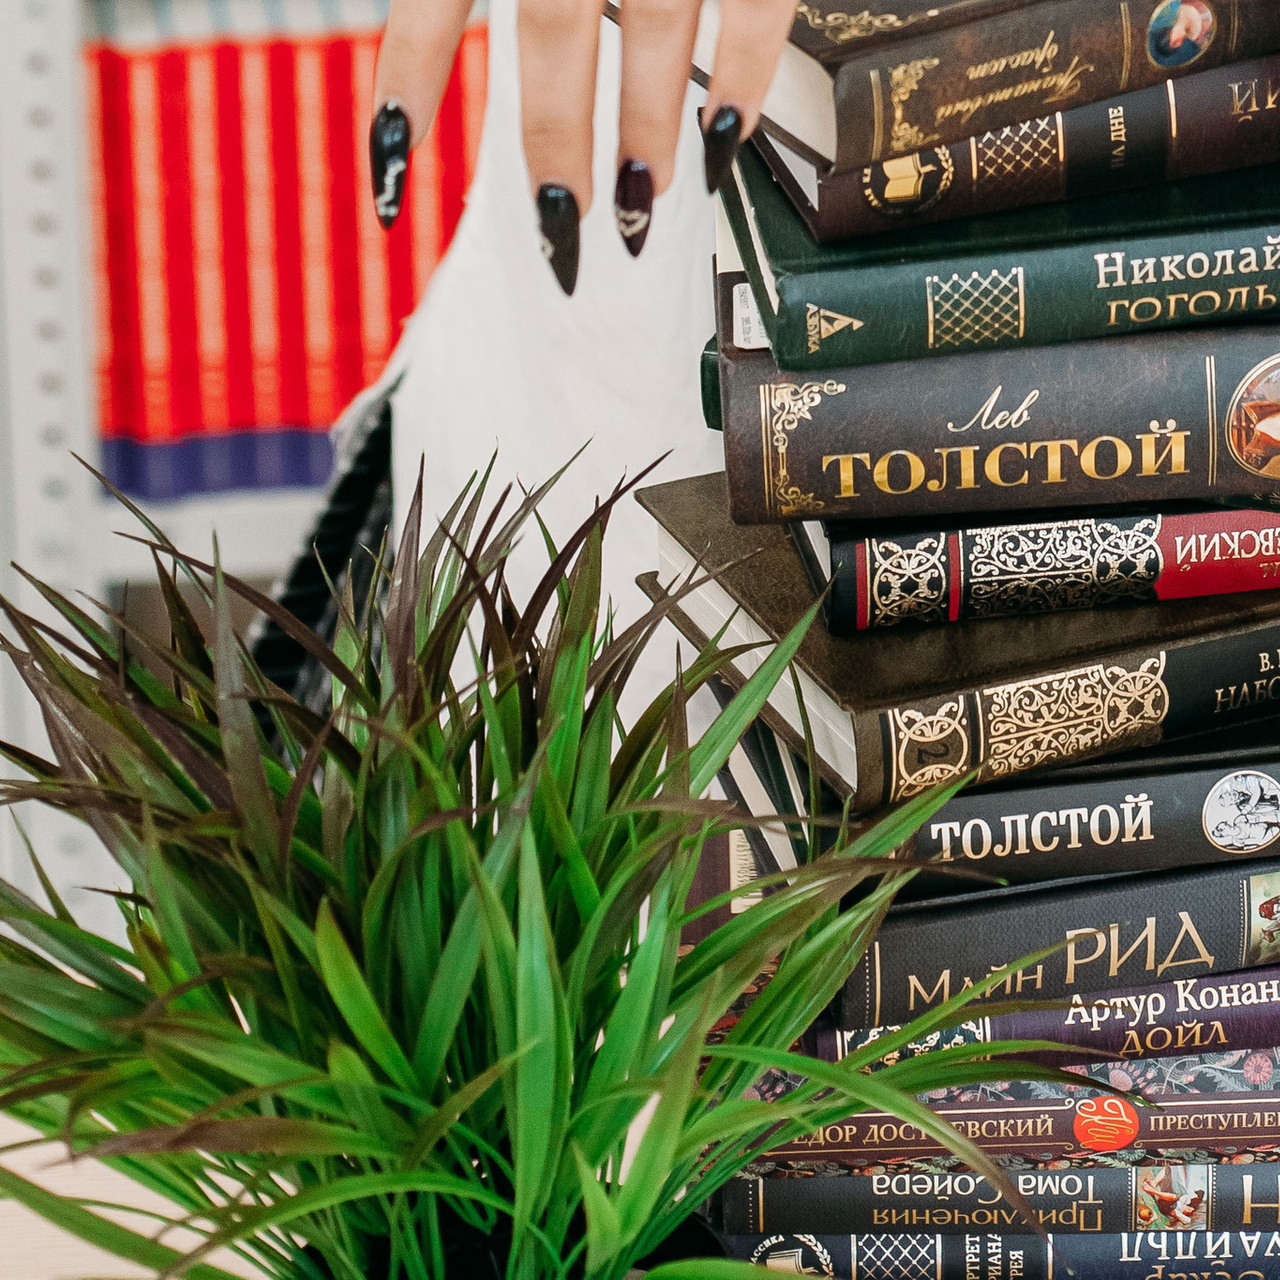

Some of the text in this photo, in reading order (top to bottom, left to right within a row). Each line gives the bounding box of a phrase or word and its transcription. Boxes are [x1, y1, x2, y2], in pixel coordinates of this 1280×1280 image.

[1108, 105, 1126, 143] ДНЕ
[1106, 284, 1278, 326] ГОГОЛЬ
[947, 385, 1040, 432] Лев
[822, 419, 1191, 499] ТОЛСТОЙ
[930, 793, 1154, 862] ТОЛСТОЙ
[1065, 911, 1215, 984] РИД
[1064, 992, 1166, 1031] Артур
[1118, 1018, 1229, 1058] ДОЙЛ
[862, 1114, 1054, 1145] ДОСТЕВСКИЙ
[1018, 1175, 1104, 1204] Тома
[965, 1233, 981, 1280] РТРЕТ
